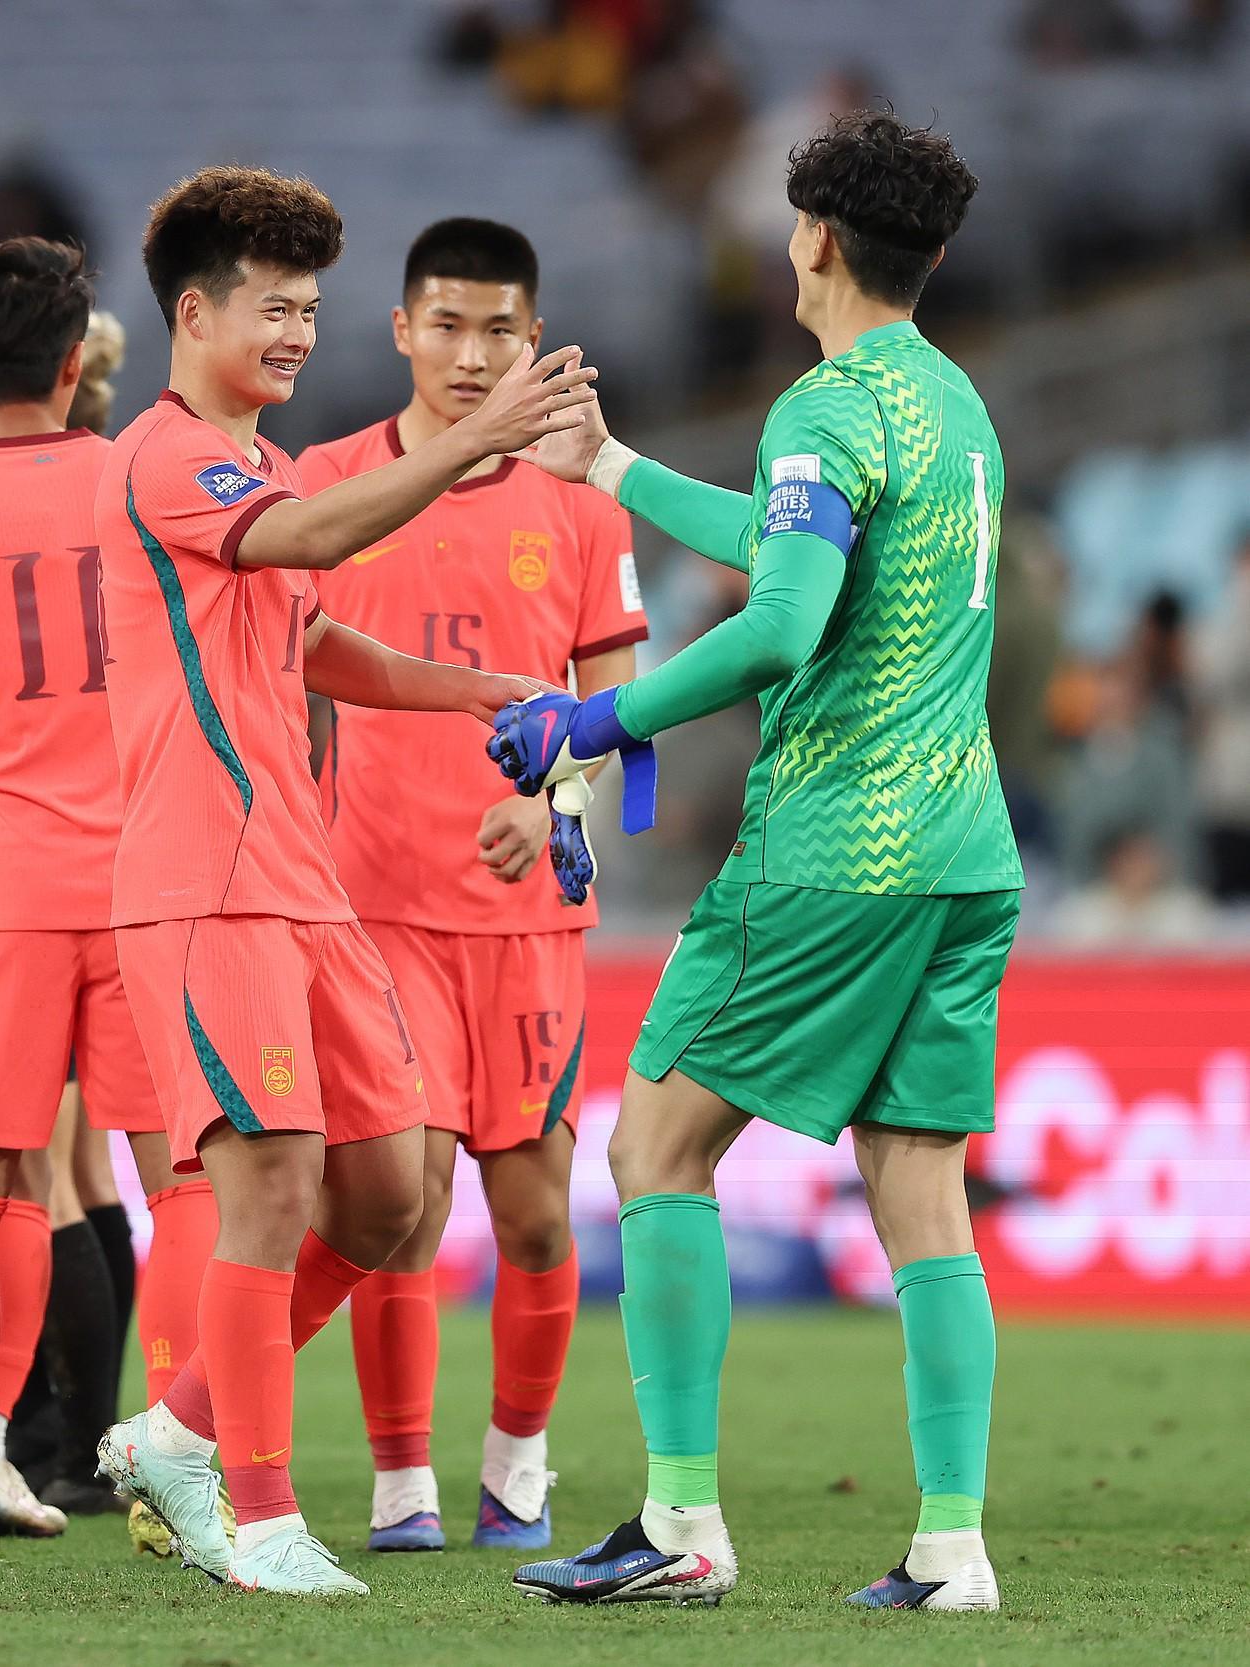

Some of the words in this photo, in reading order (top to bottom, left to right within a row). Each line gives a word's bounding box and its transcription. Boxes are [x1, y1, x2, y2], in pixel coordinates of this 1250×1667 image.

[966, 452, 988, 610] 1
[0, 545, 108, 700] 11
[264, 1050, 291, 1059] CFA
